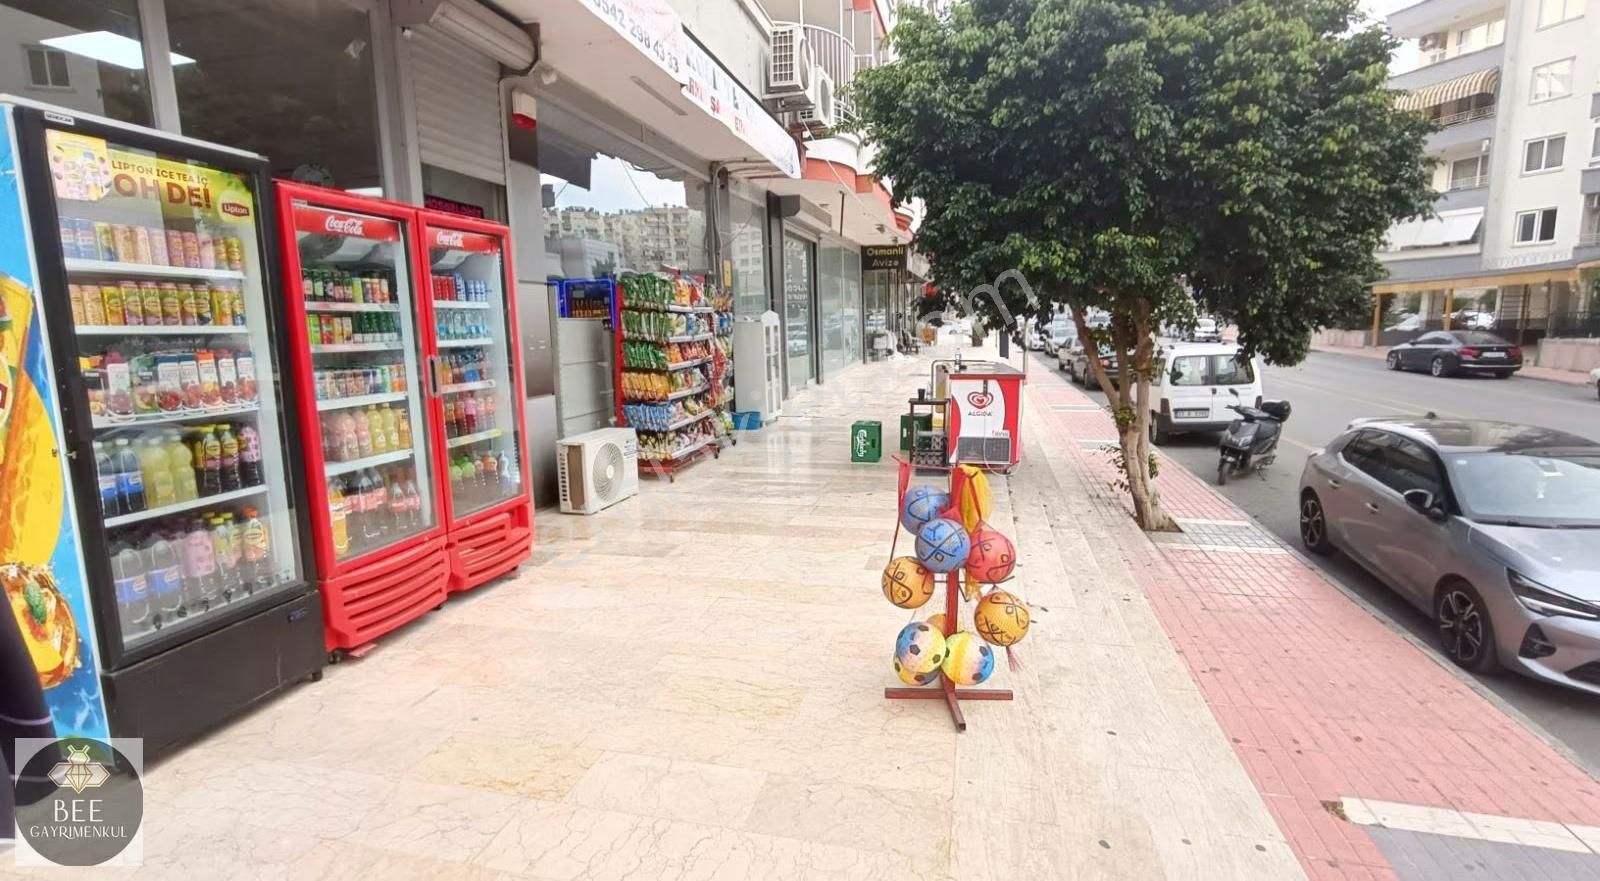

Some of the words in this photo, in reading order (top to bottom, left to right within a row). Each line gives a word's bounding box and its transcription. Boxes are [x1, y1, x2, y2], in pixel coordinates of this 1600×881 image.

[112, 160, 153, 176] LIPTON
[156, 169, 175, 180] ICE
[176, 173, 195, 184] TEA
[113, 173, 160, 201] OH
[166, 181, 212, 209] DE!
[223, 203, 249, 215] Lipton
[872, 258, 899, 267] Avize
